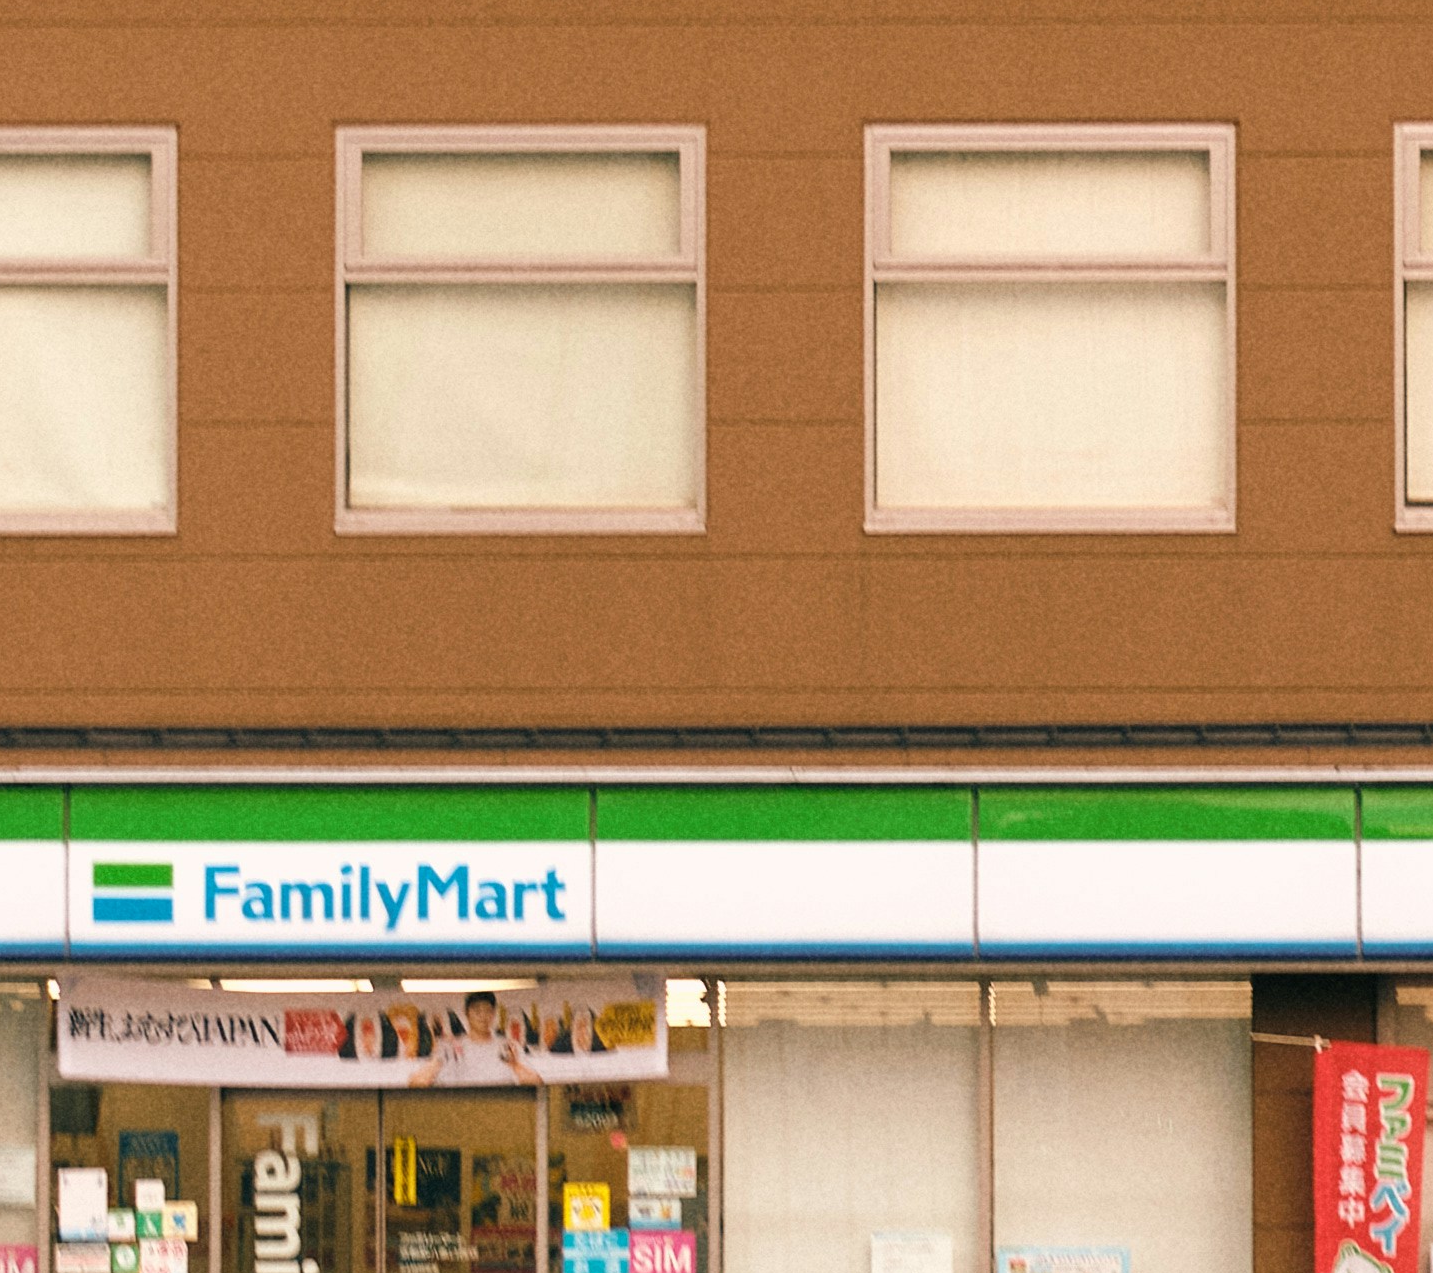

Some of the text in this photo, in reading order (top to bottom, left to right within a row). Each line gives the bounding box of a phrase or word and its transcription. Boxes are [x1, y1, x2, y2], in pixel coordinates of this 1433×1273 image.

[204, 862, 567, 932] FamilyMart
[1339, 1069, 1369, 1229] 会員募集中
